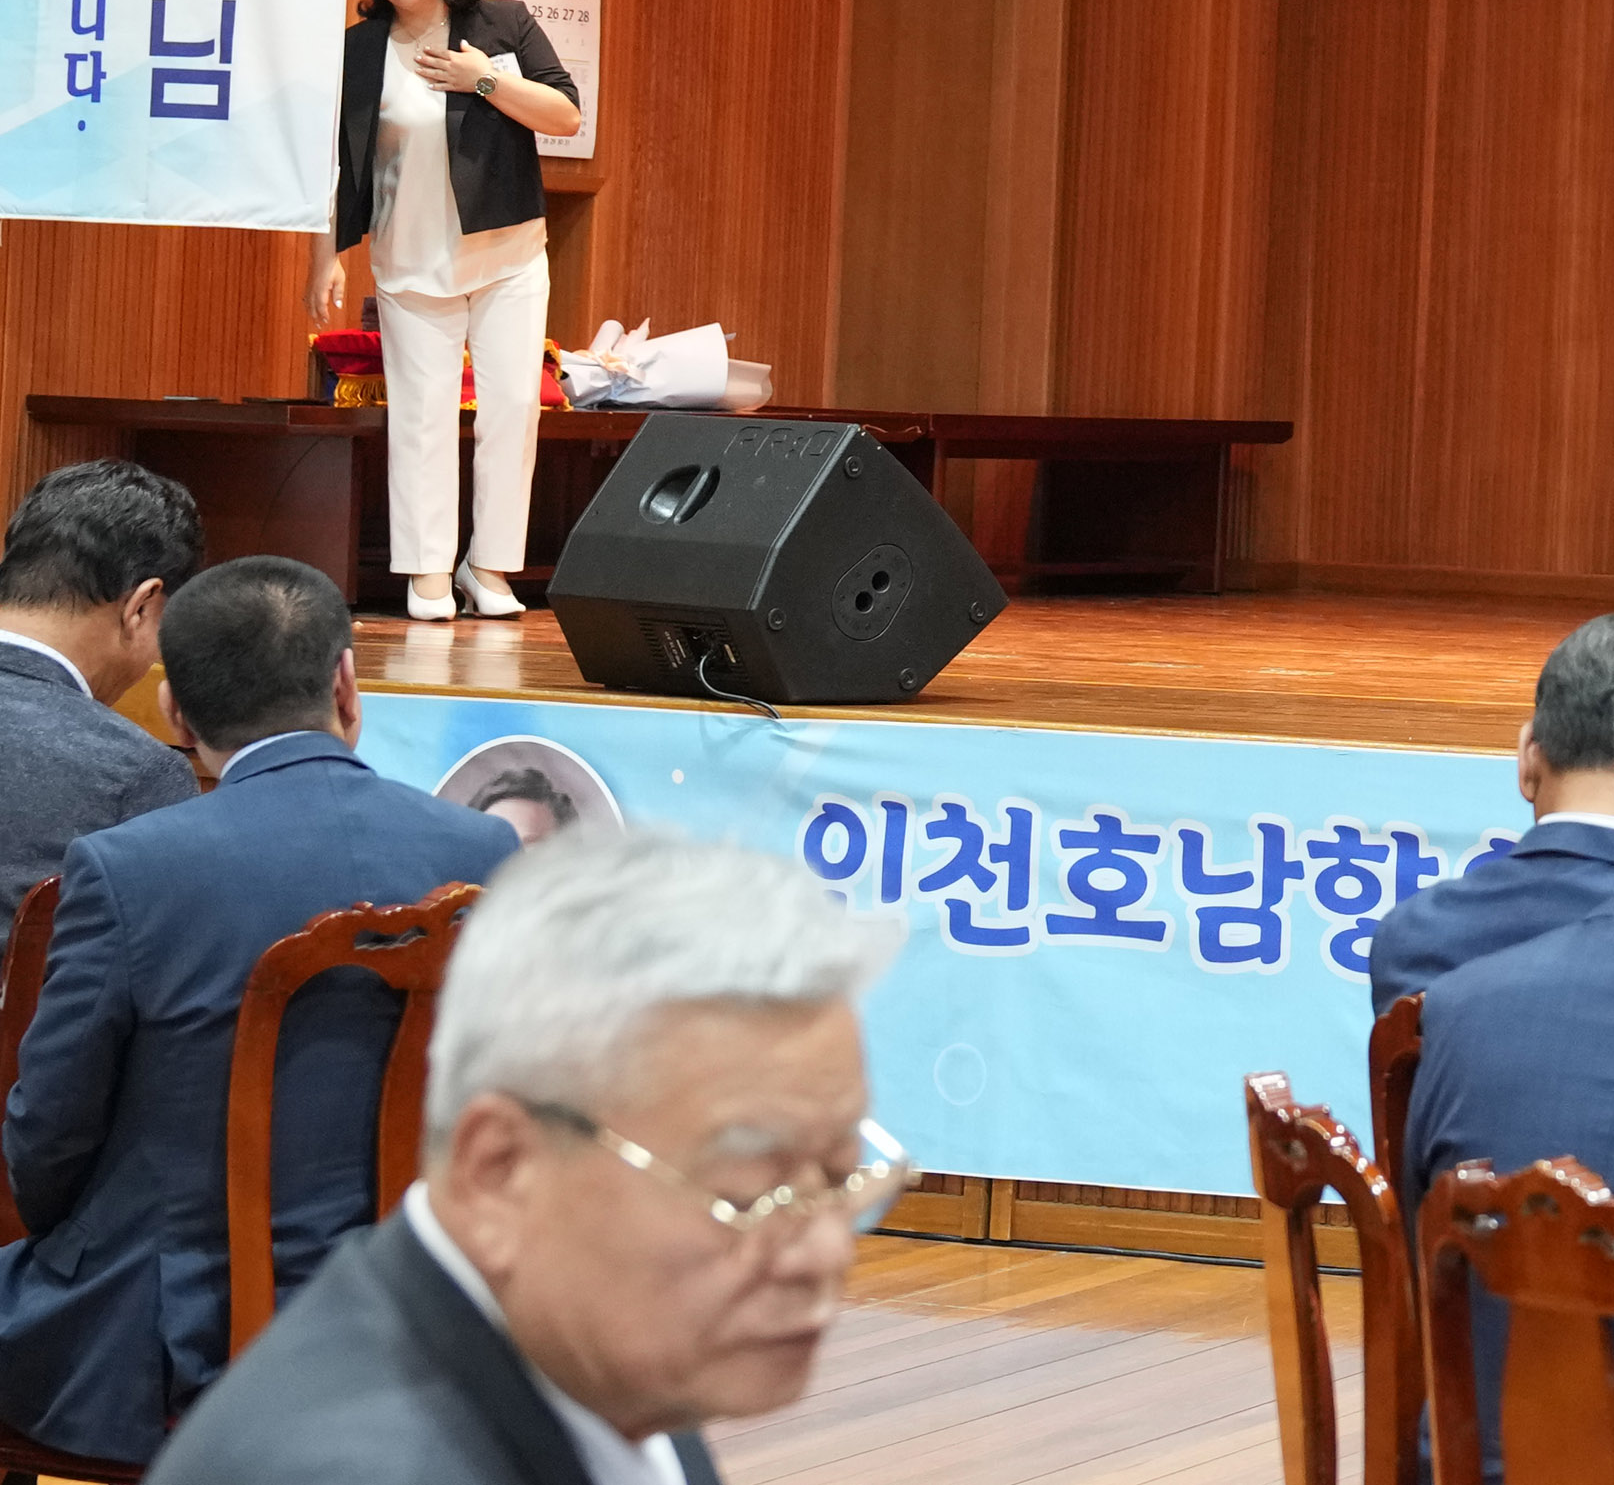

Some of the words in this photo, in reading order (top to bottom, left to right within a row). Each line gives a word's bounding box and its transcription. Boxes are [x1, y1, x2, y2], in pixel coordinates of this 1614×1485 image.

[532, 5, 543, 18] 25
[547, 7, 559, 19] 26
[563, 9, 574, 21] 27
[578, 11, 590, 23] 28
[803, 799, 1520, 977] 인천호남향
